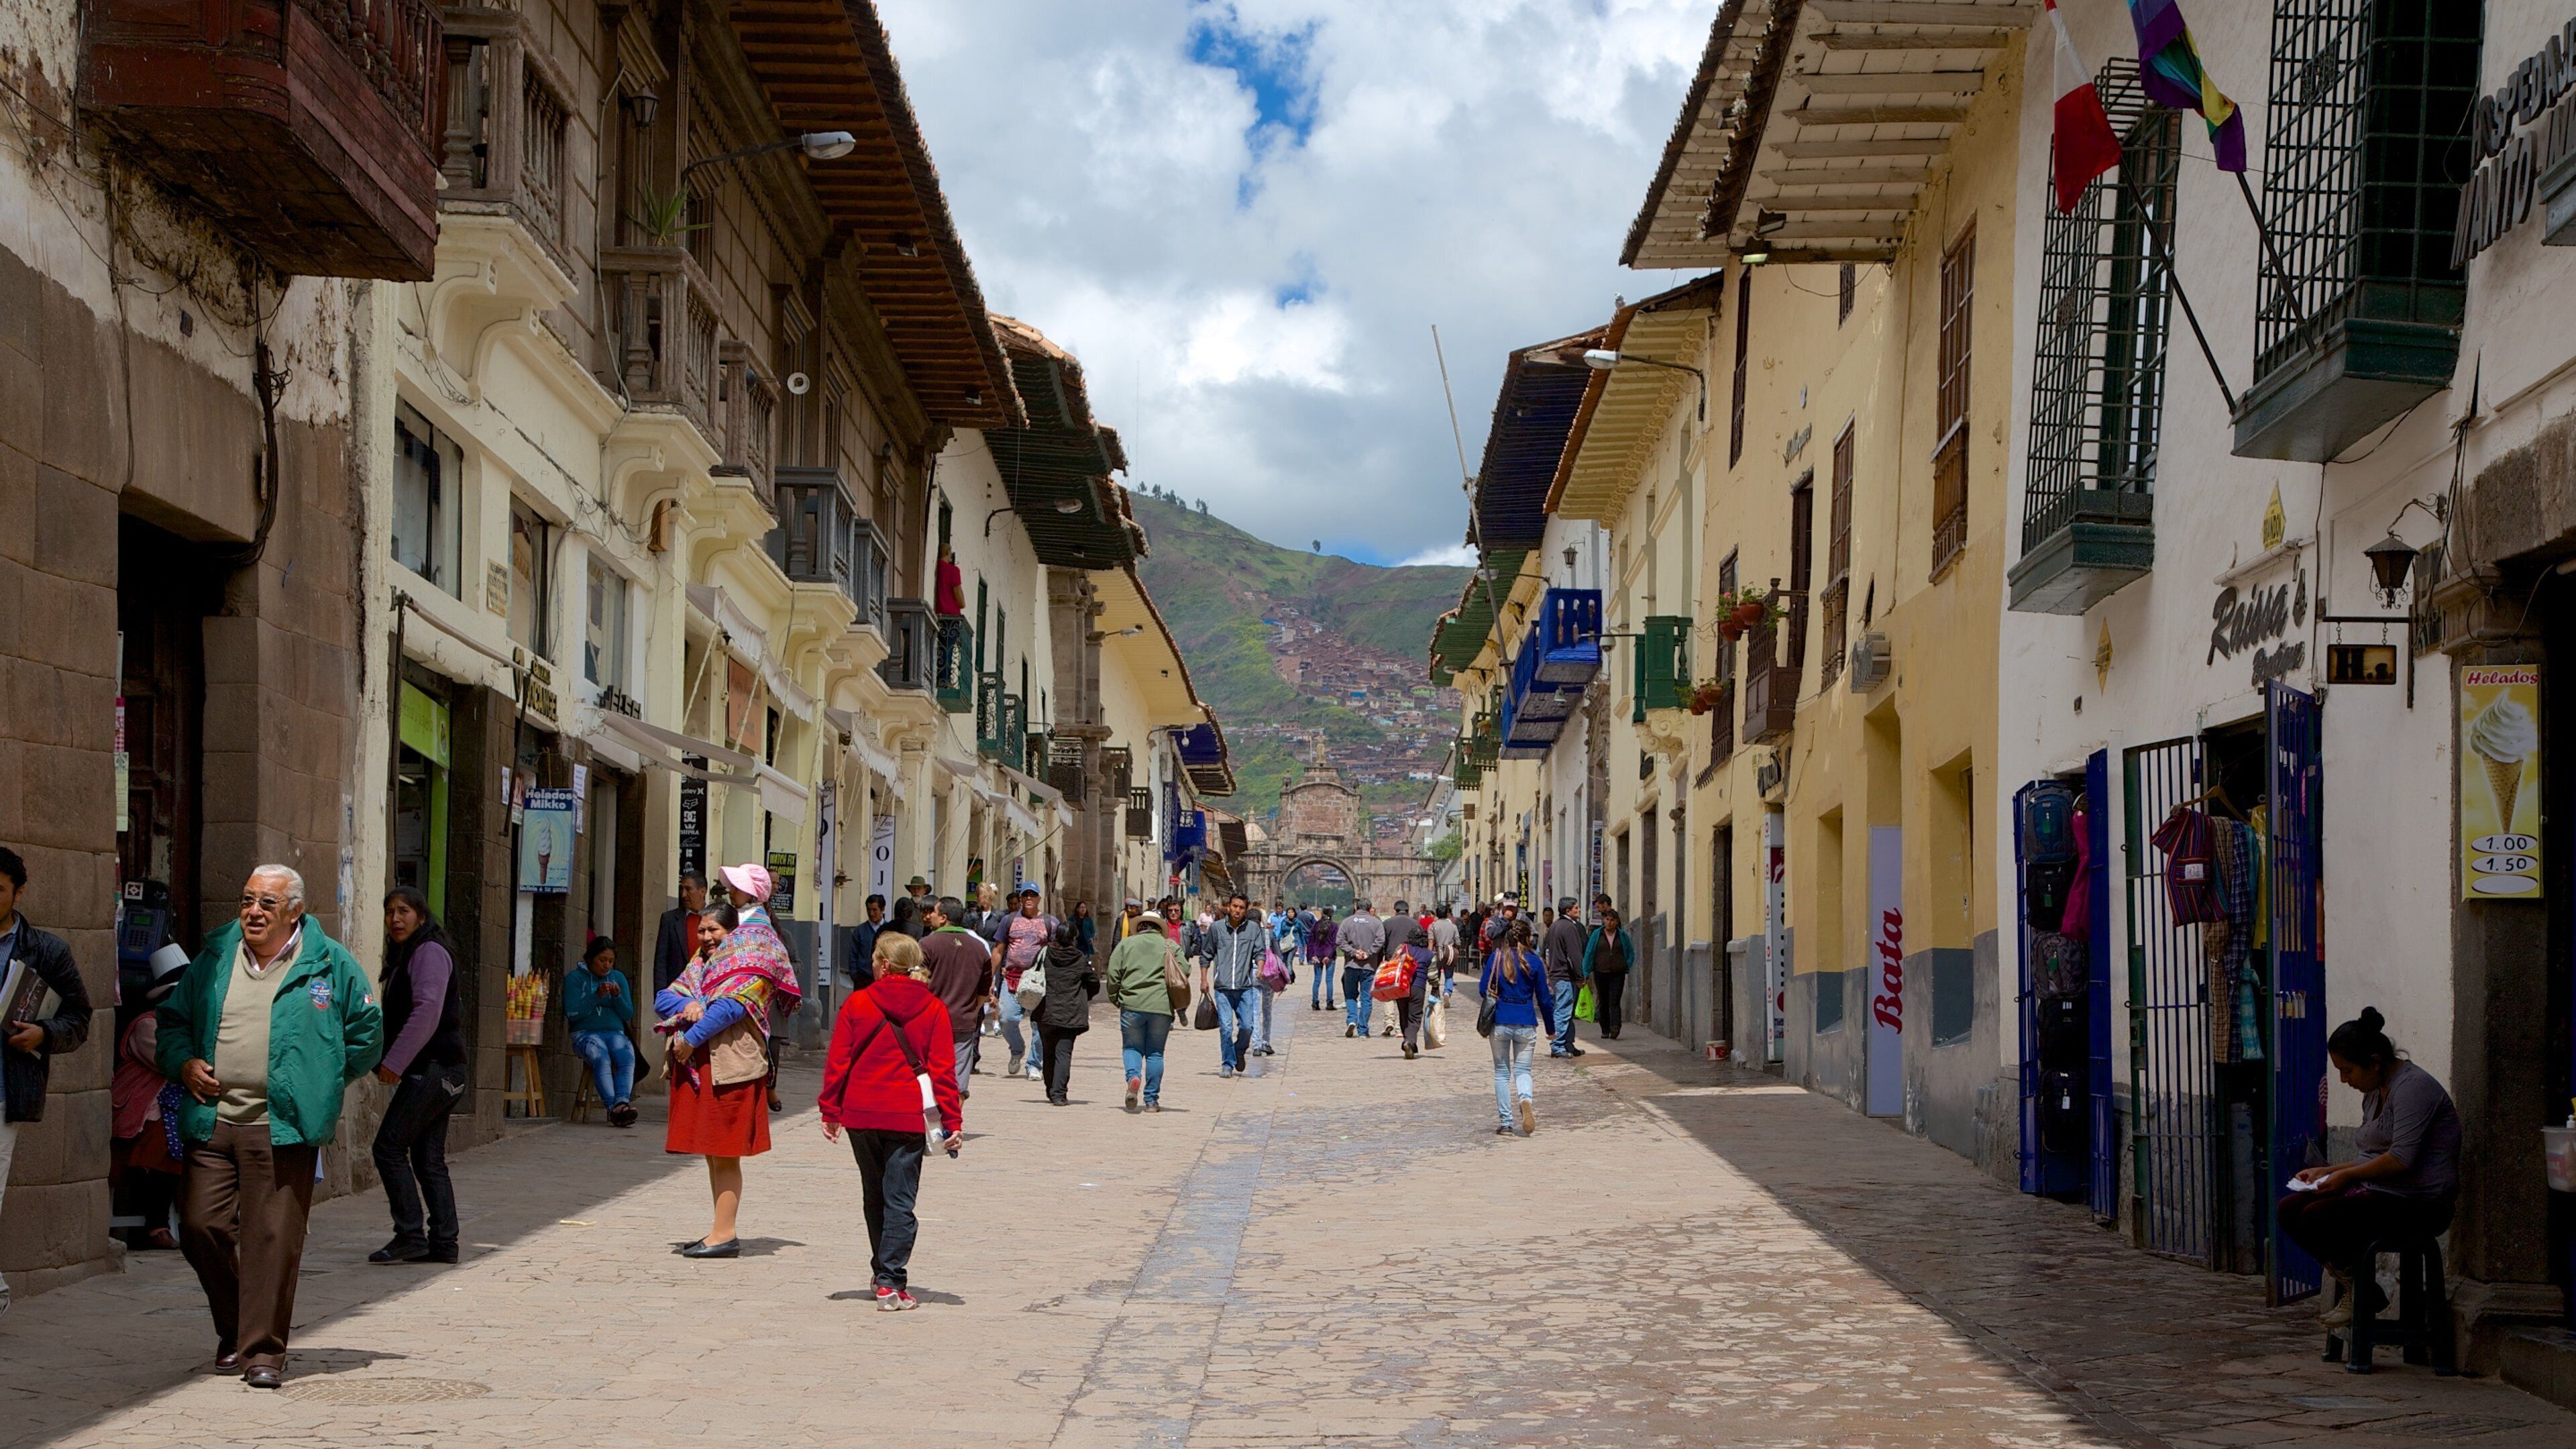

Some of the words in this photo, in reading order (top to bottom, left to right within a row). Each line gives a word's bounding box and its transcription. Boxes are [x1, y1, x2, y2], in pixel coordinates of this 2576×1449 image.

[2450, 130, 2538, 270] MANTO
[2466, 670, 2540, 686] Helados
[525, 789, 574, 800] Helados
[682, 788, 697, 796] urley
[530, 799, 567, 810] Mikko
[2486, 837, 2528, 851] 1.00
[2486, 857, 2527, 871] 1.50
[1873, 907, 1904, 1034] Bata
